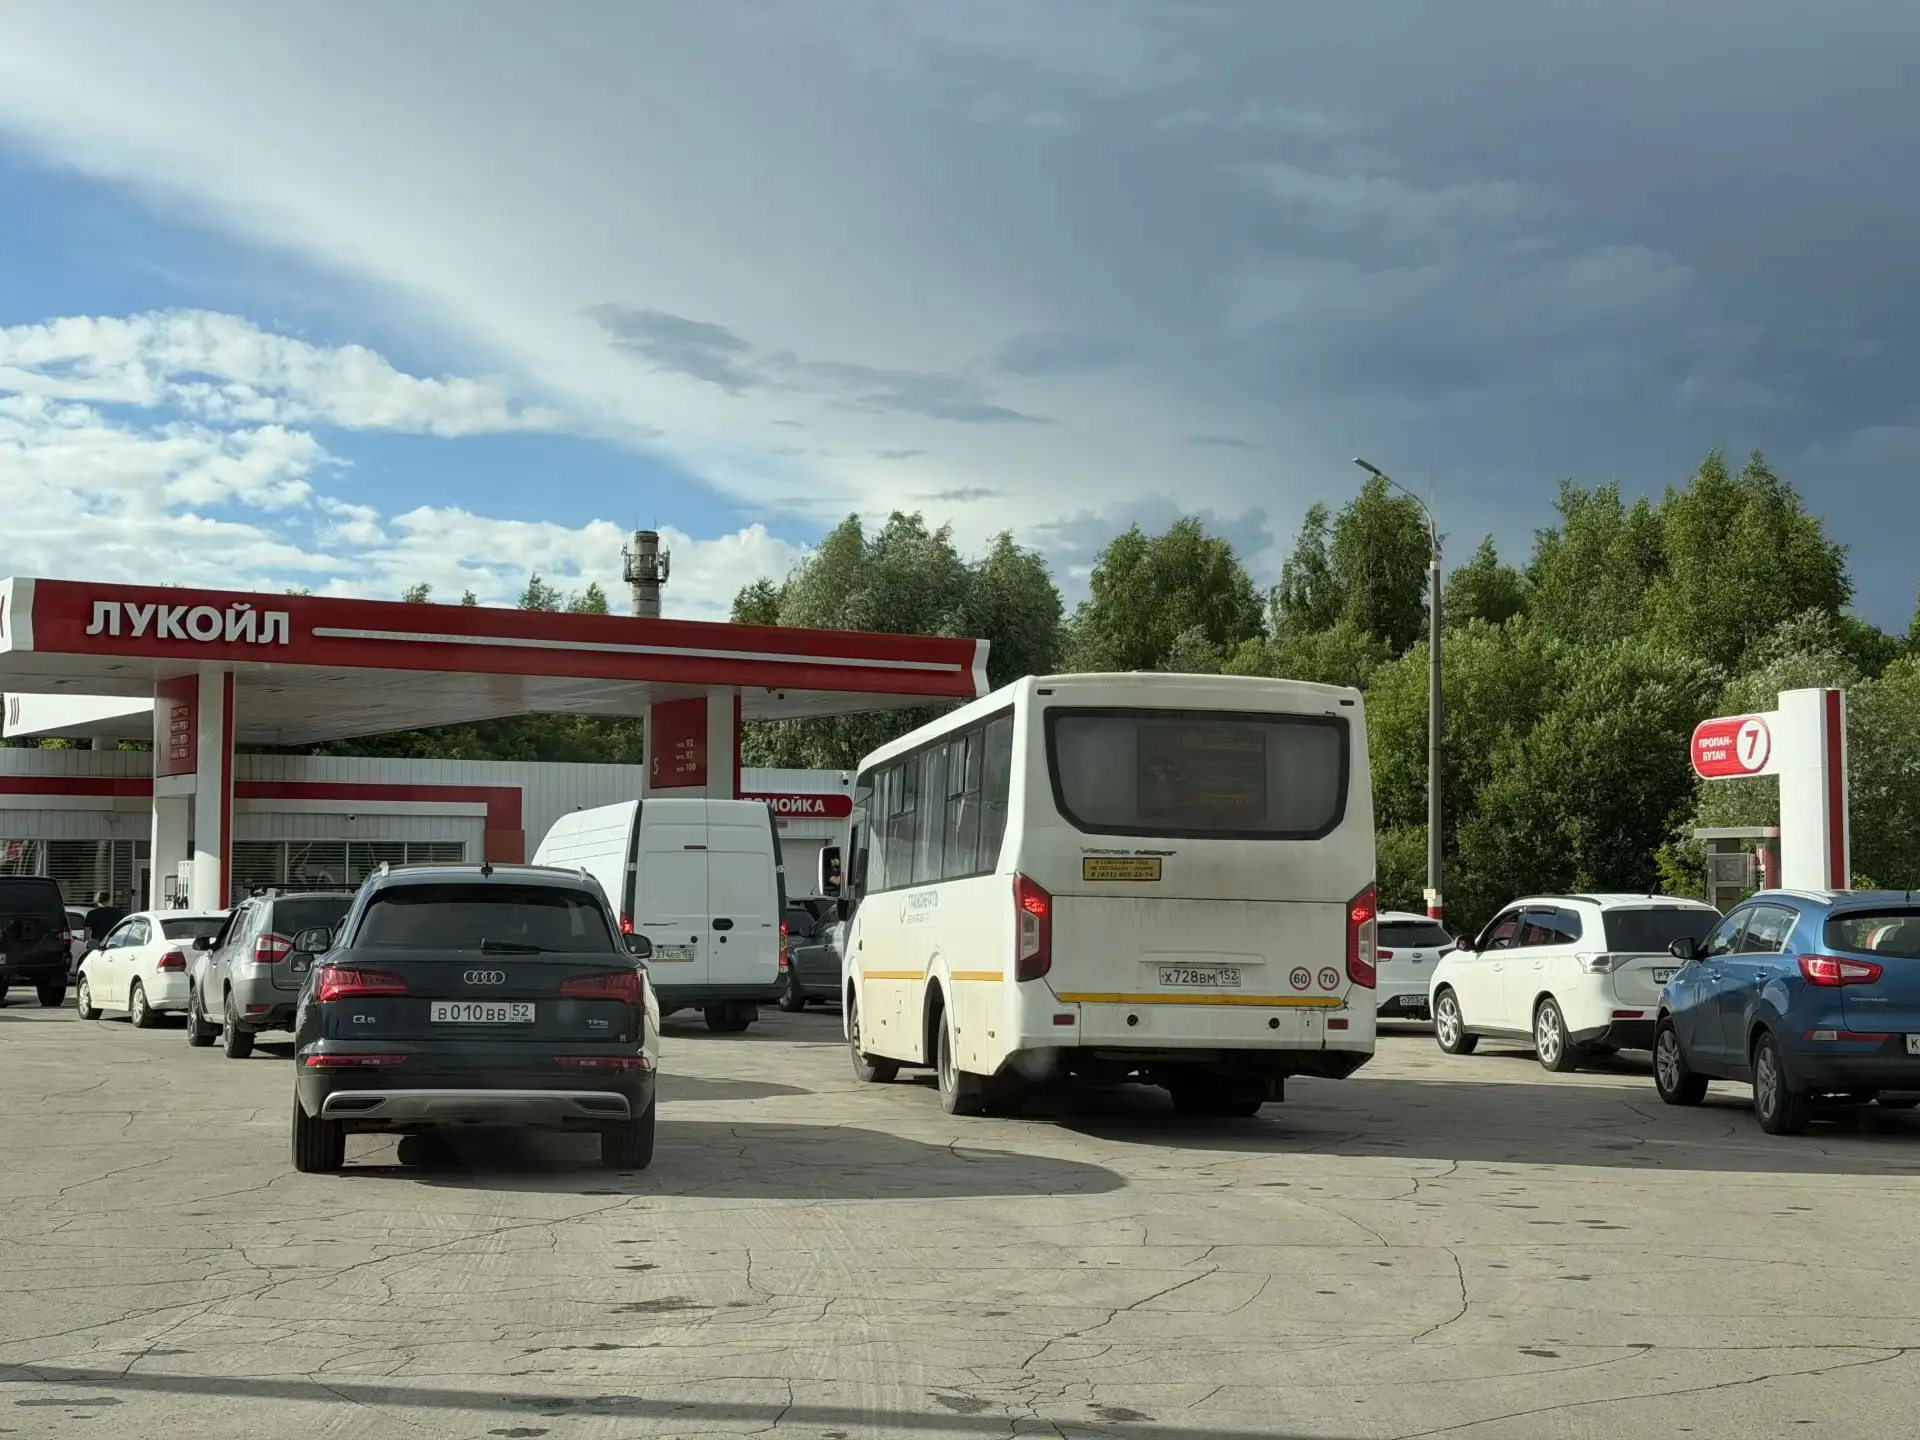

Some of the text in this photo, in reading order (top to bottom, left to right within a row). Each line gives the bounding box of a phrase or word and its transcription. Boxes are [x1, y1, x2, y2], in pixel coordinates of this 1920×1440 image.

[86, 601, 289, 645] ЛУКОЙЛ
[686, 738, 694, 747] 92
[1699, 736, 1732, 748] ПРОПАН-
[1745, 729, 1759, 760] 7
[1703, 750, 1726, 761] БУТАН
[653, 757, 659, 776] 5
[686, 762, 696, 771] 100
[744, 796, 826, 813] МОЙКА
[1165, 970, 1237, 984] Х728ВМ 152
[1293, 973, 1308, 984] 60
[1322, 973, 1335, 984] 70
[438, 1004, 529, 1021] В010ВВ 52
